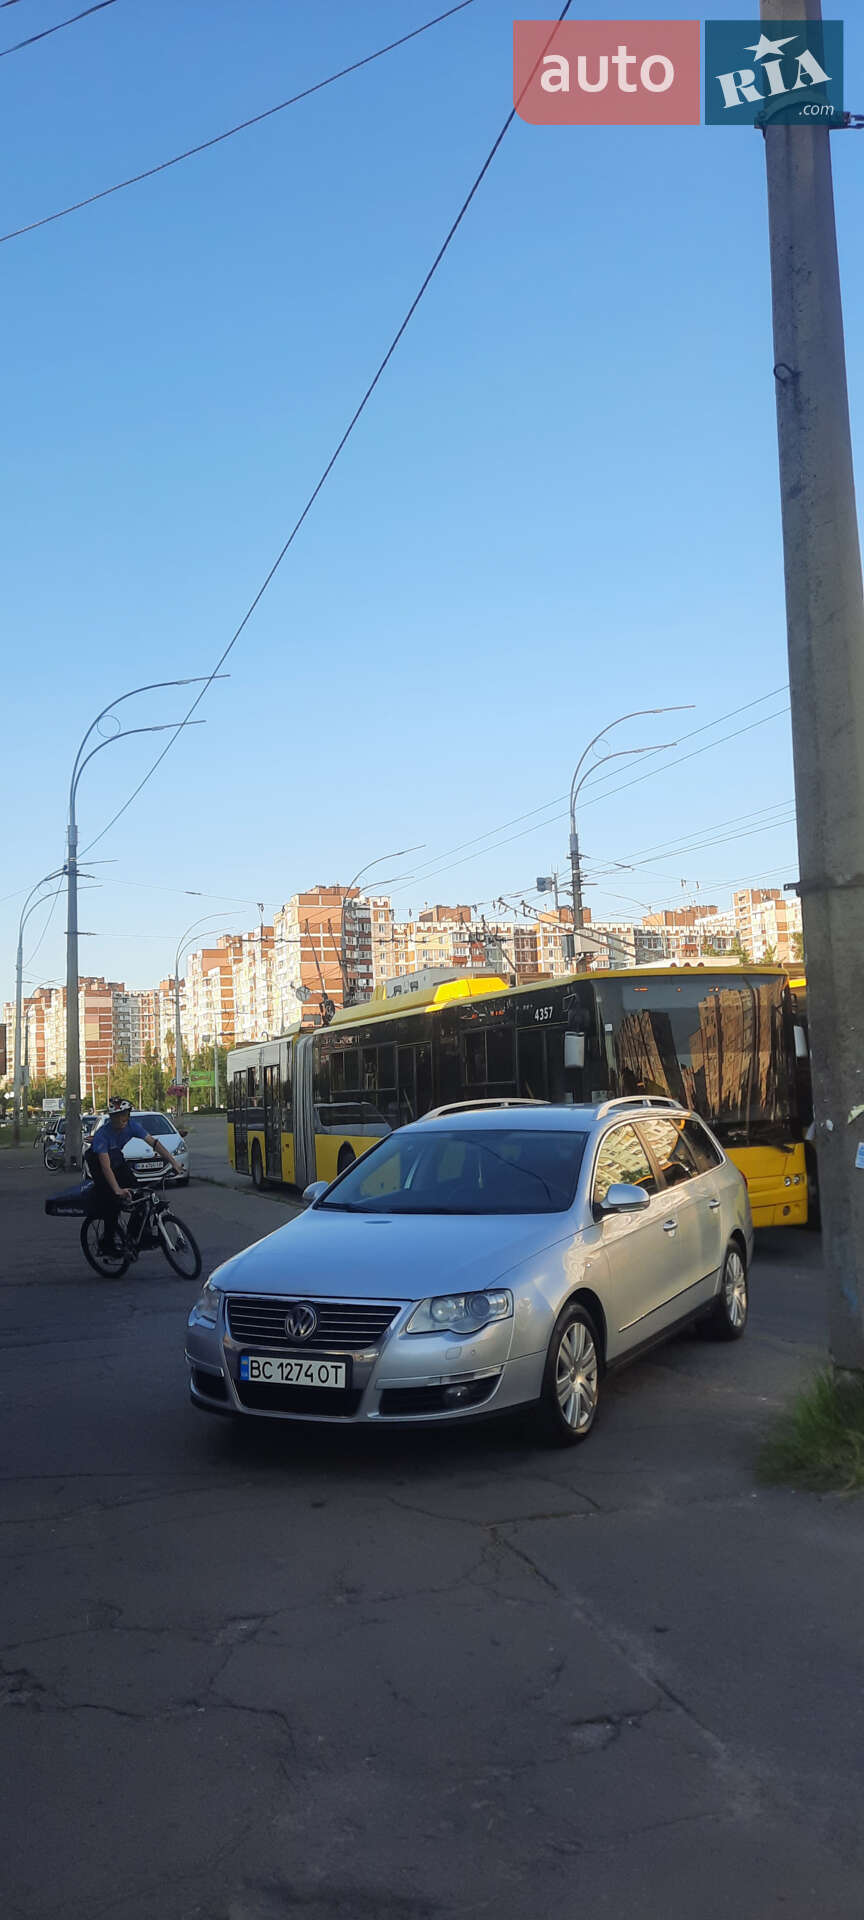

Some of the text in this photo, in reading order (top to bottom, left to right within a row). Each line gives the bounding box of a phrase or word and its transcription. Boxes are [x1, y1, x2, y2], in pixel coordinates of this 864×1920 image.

[534, 1006, 553, 1021] 4357
[250, 1360, 273, 1379] BC
[277, 1362, 314, 1383] 1274
[318, 1365, 343, 1384] OT
